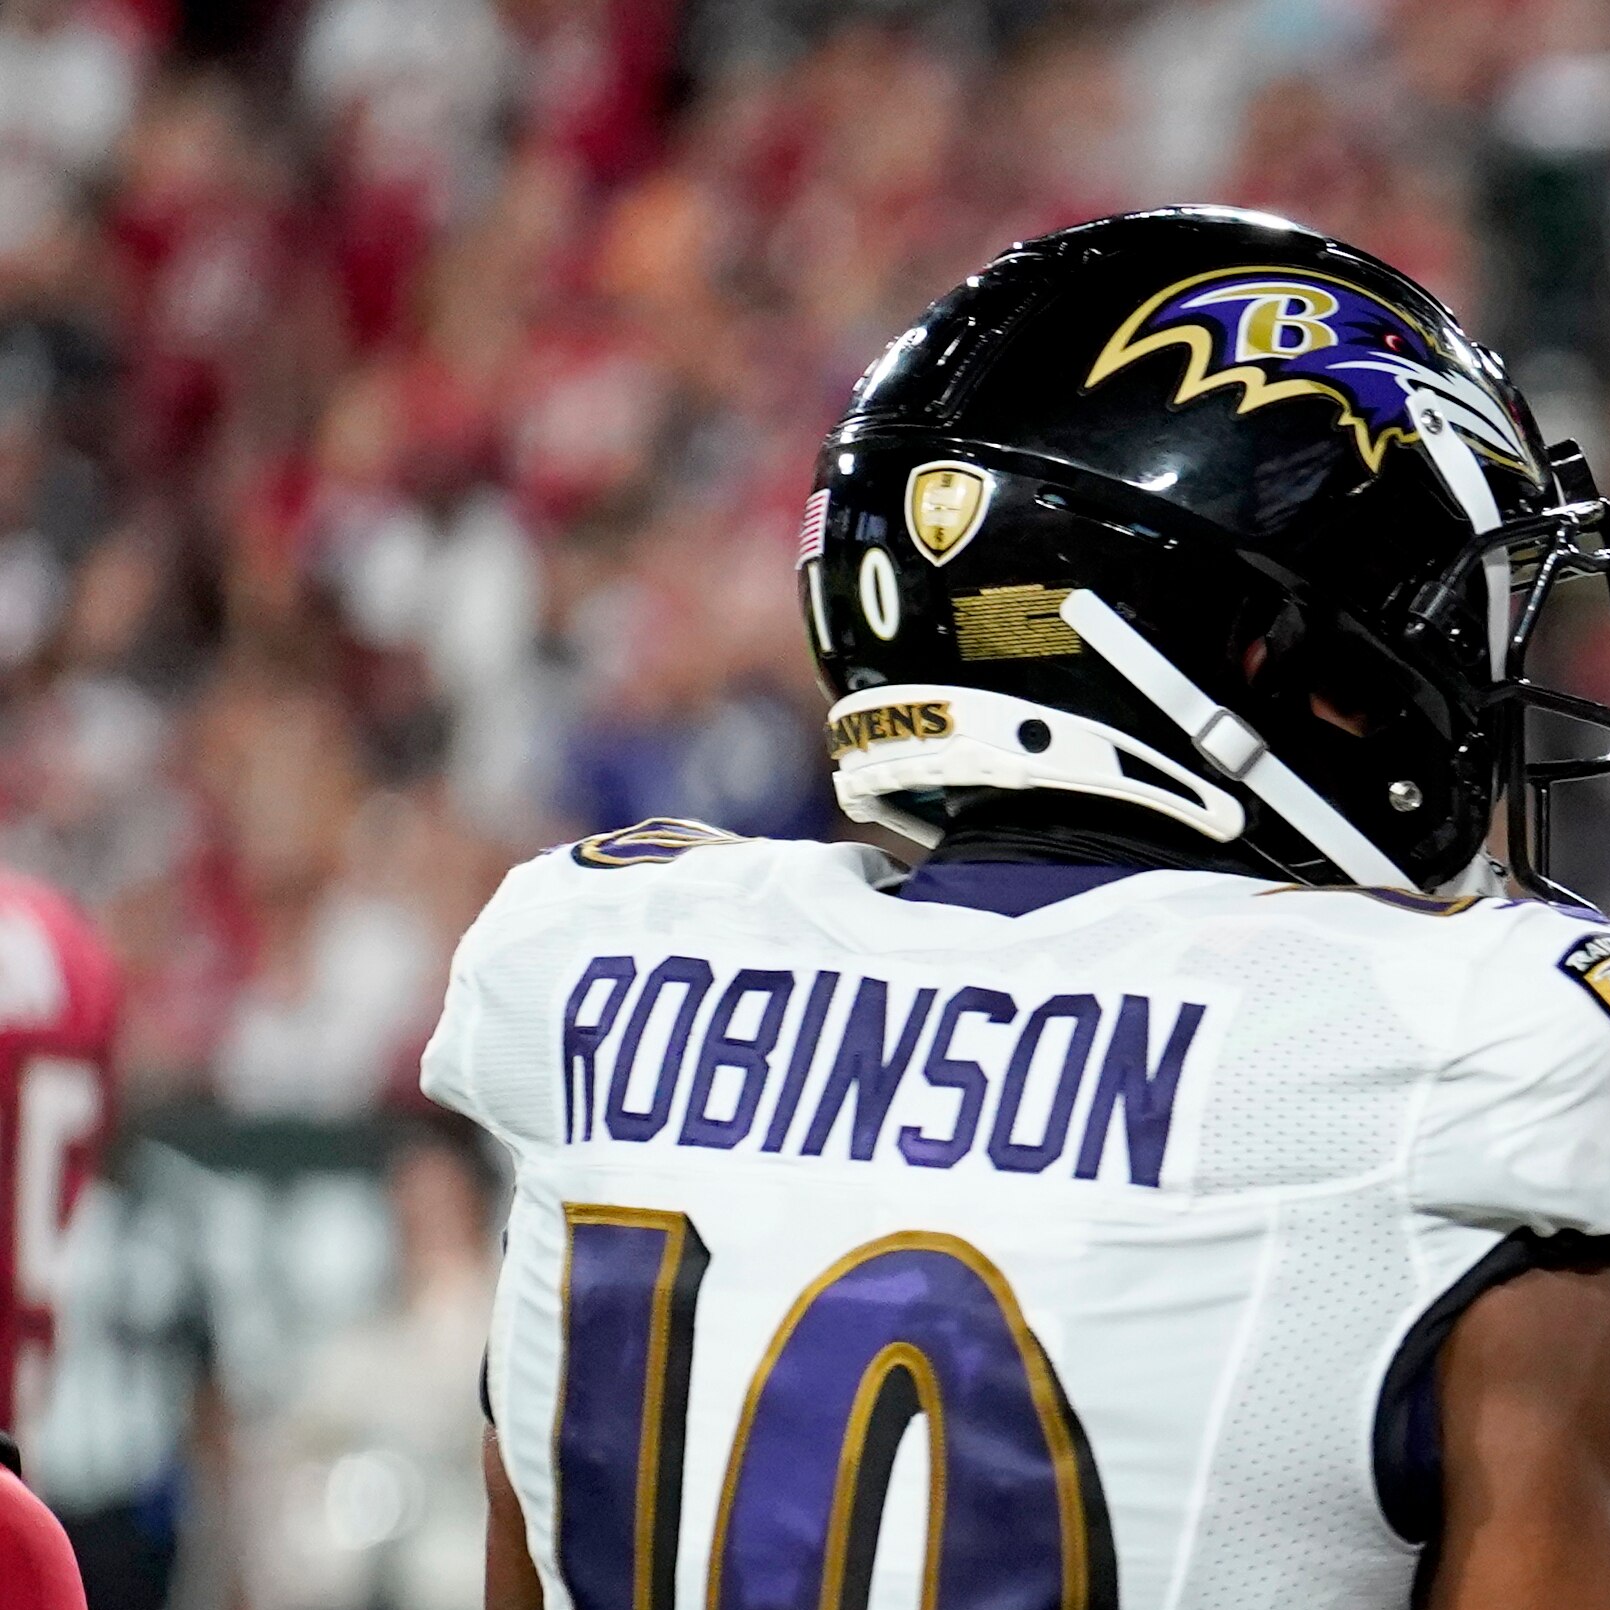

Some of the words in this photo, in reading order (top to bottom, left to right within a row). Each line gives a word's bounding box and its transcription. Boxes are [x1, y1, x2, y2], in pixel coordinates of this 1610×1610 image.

[1180, 280, 1339, 361] B
[828, 700, 955, 759] AVENS
[562, 953, 1207, 1188] ROBINSON
